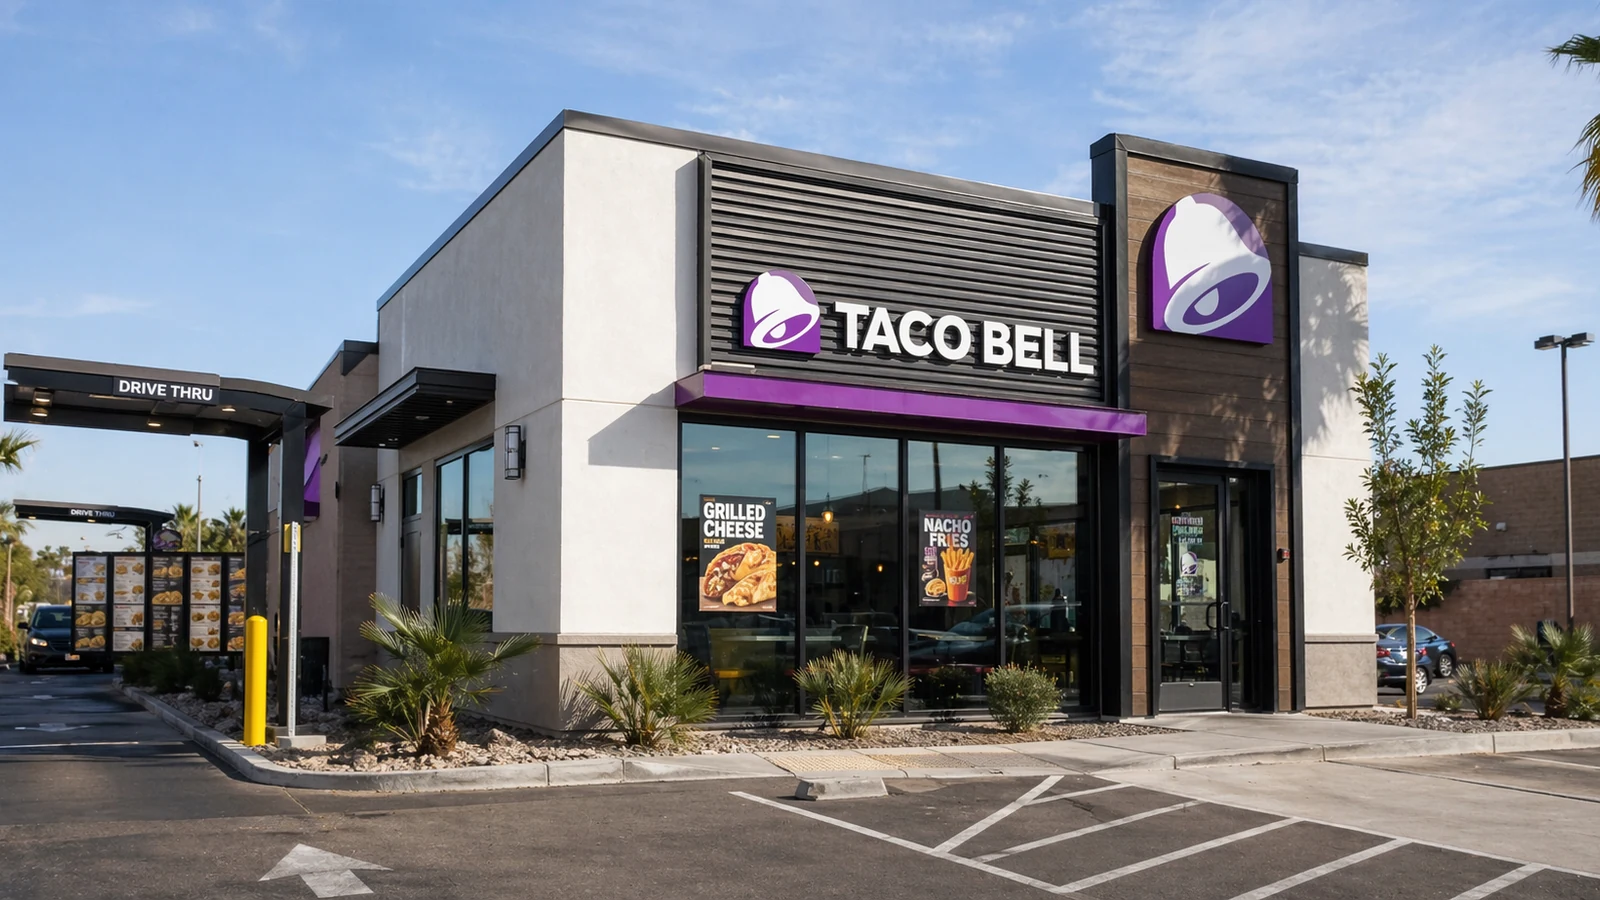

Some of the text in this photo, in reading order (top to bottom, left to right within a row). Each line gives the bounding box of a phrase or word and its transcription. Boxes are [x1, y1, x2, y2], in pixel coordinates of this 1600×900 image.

[834, 301, 1094, 375] TACO BELL
[119, 380, 213, 401] DRIVE THRU
[70, 508, 115, 518] DRIVE THRU
[703, 501, 766, 521] GRILLED
[703, 520, 764, 539] CHEESE
[924, 517, 972, 534] NACHO
[929, 532, 969, 548] FRIES
